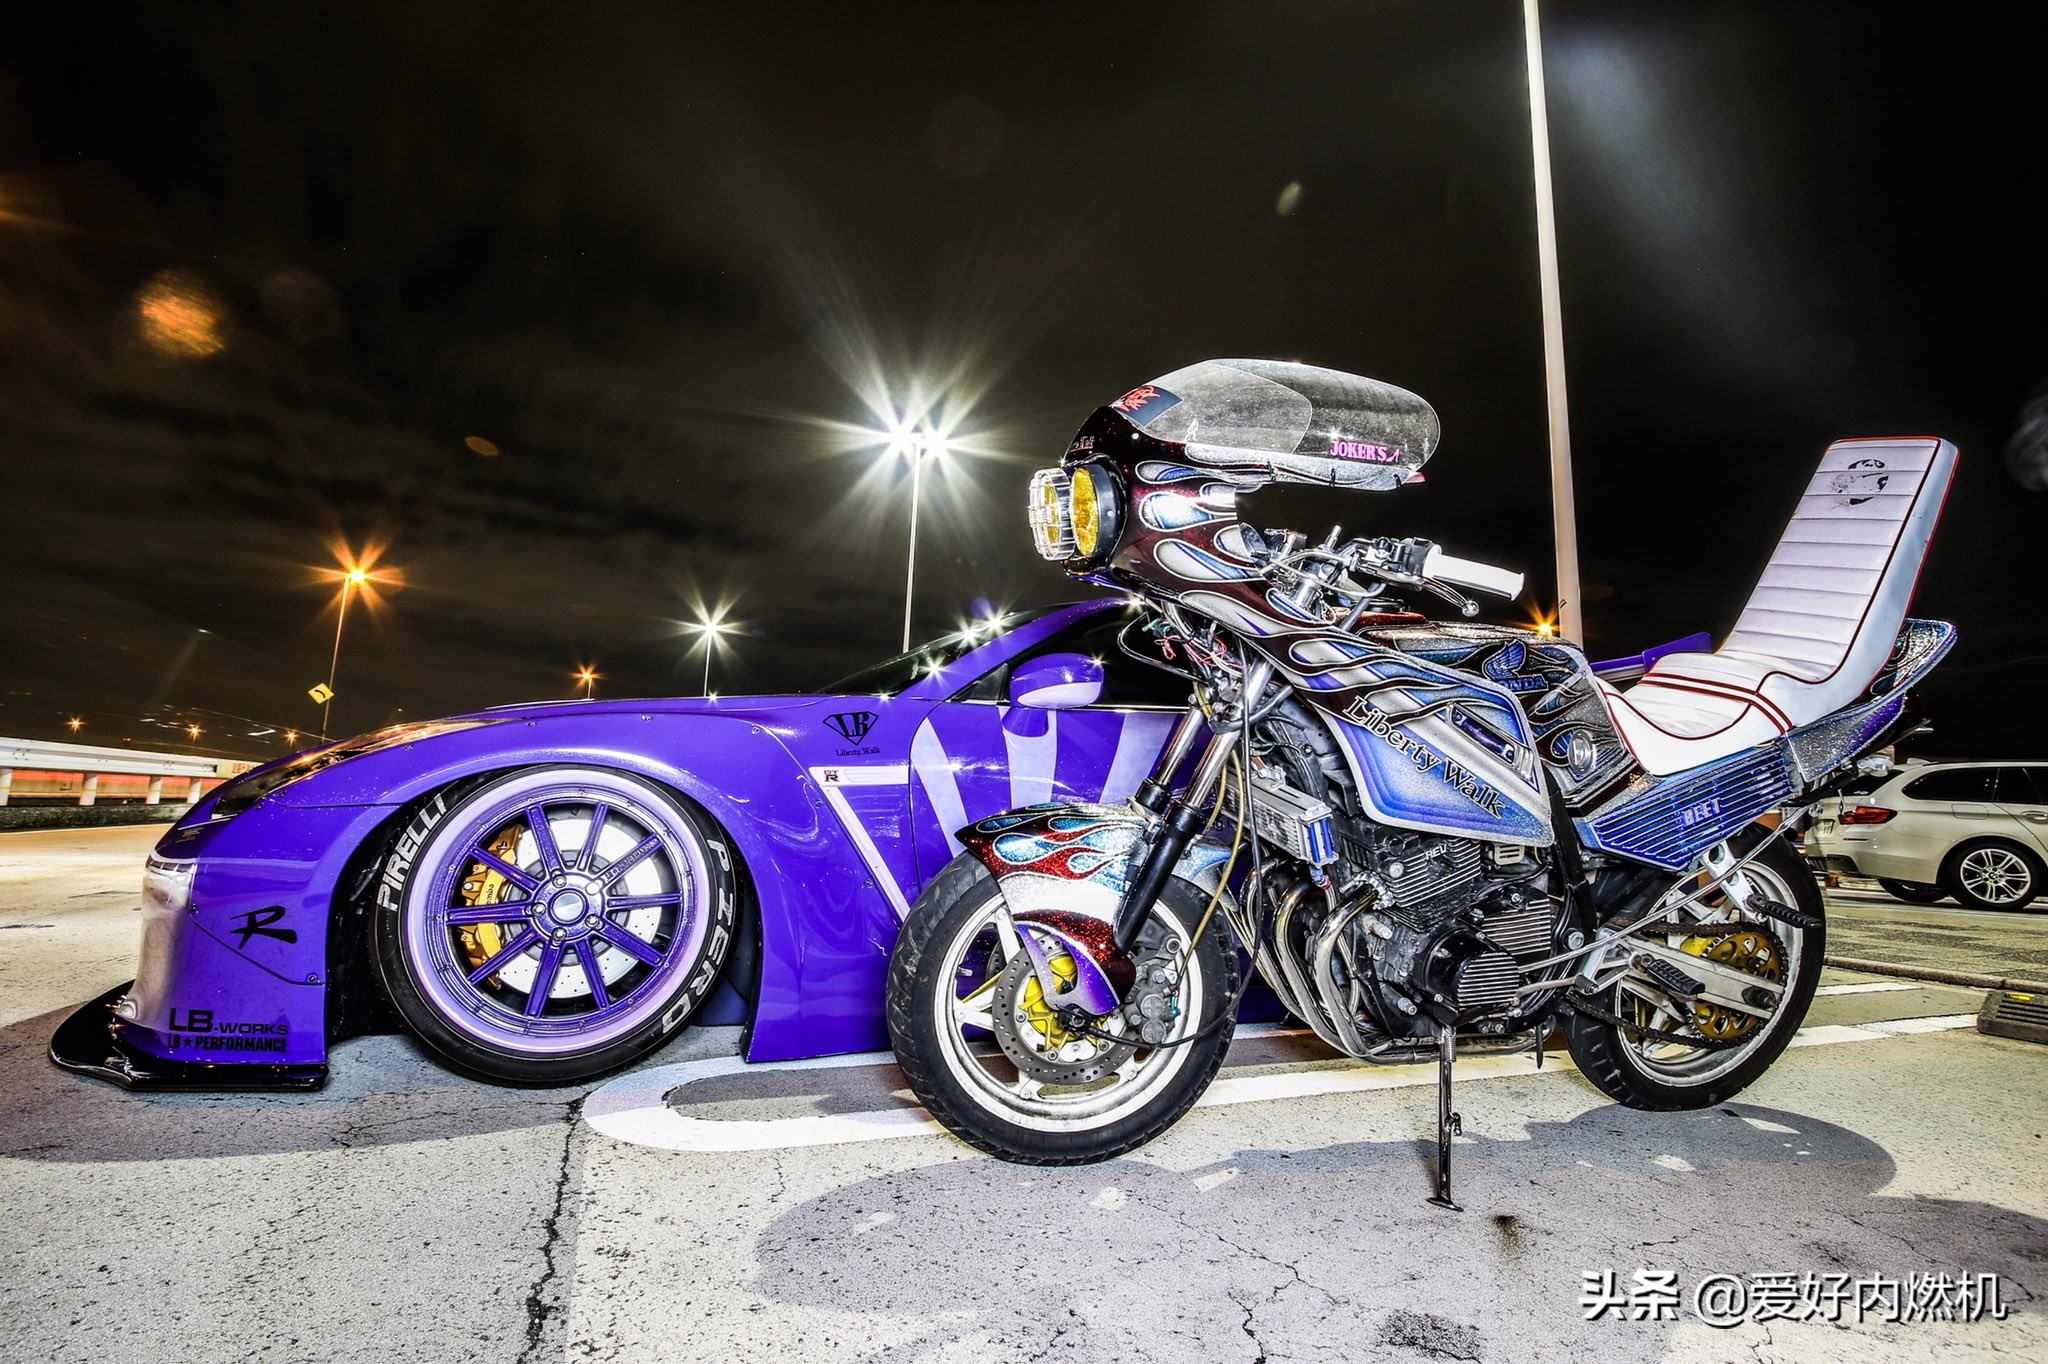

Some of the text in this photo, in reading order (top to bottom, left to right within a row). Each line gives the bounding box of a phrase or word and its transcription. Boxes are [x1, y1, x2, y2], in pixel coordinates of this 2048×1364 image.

[1330, 441, 1387, 462] JOKER'S
[836, 746, 881, 757] Liberty Walk
[1343, 695, 1505, 819] Liberty Walk
[1681, 798, 1721, 826] BEET
[377, 793, 447, 911] PIRELLI
[1425, 843, 1447, 860] REV
[230, 905, 298, 950] R
